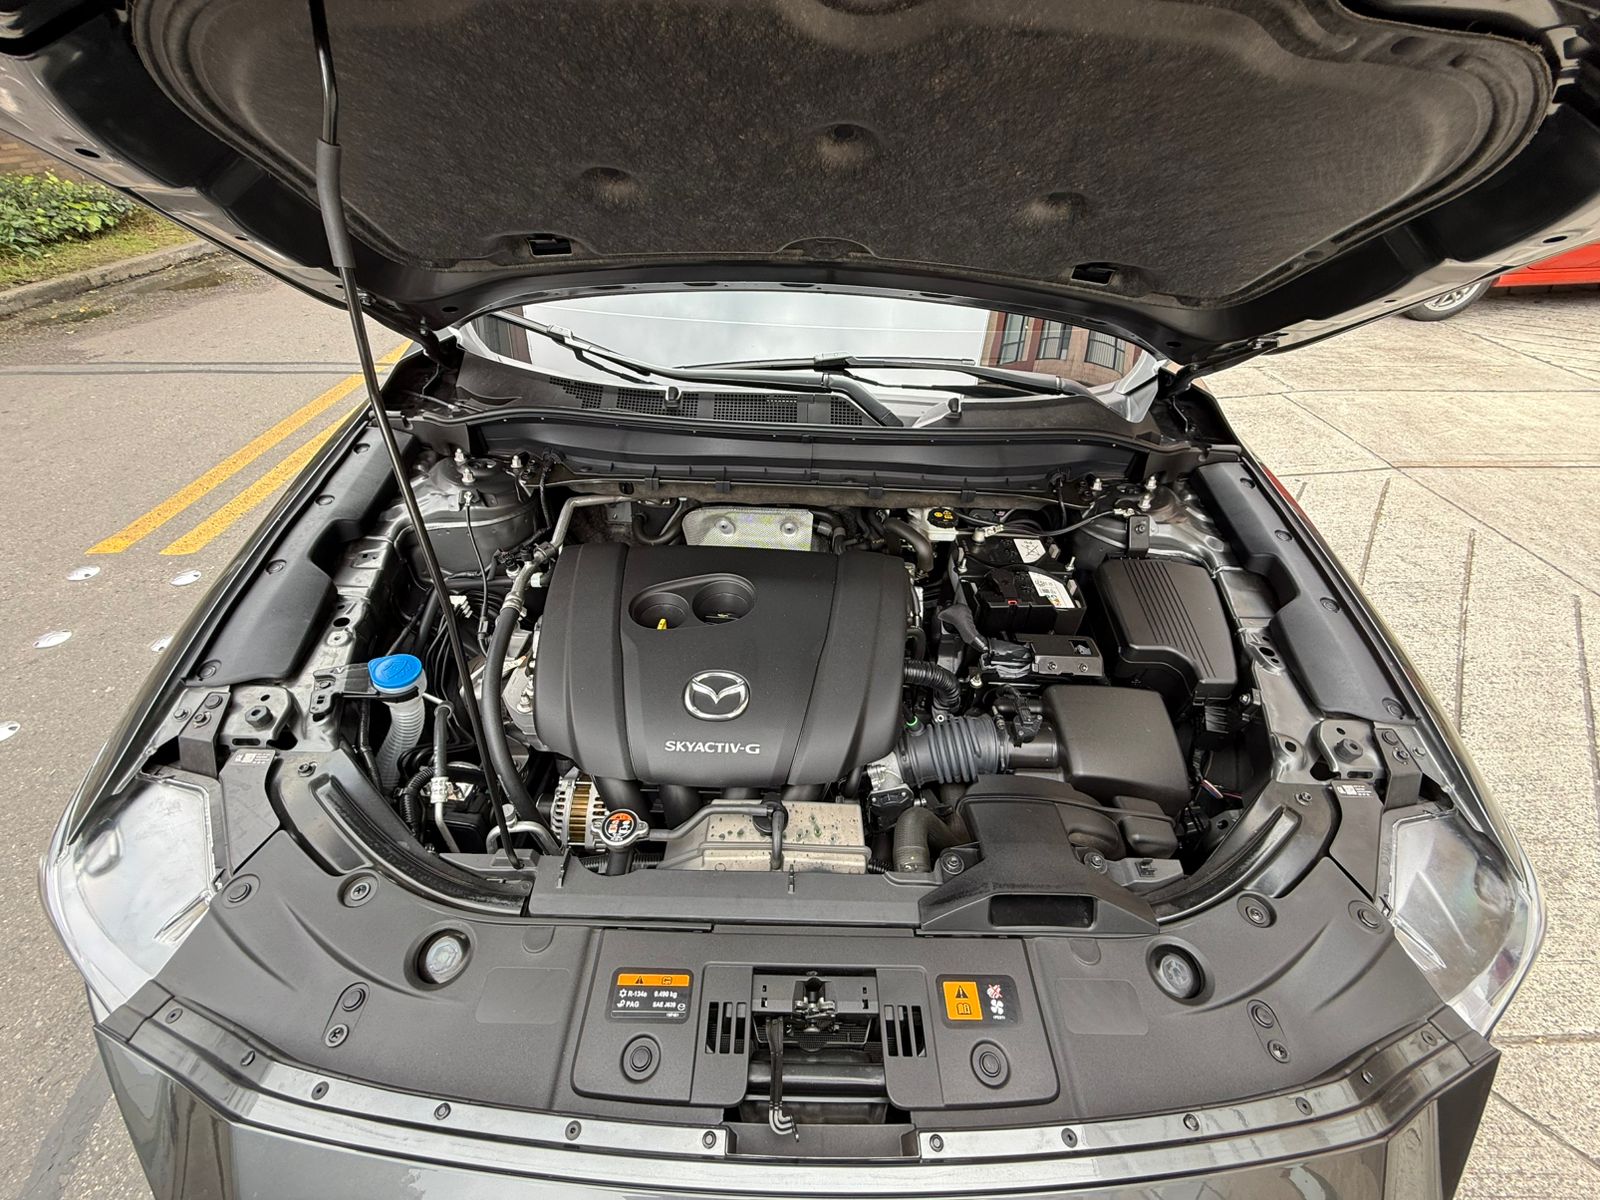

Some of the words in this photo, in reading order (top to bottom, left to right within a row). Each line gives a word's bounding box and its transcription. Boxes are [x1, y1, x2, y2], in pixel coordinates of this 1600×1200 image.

[664, 740, 761, 755] SKYACTIV-G
[669, 991, 678, 999] kg
[625, 1000, 640, 1008] PAG
